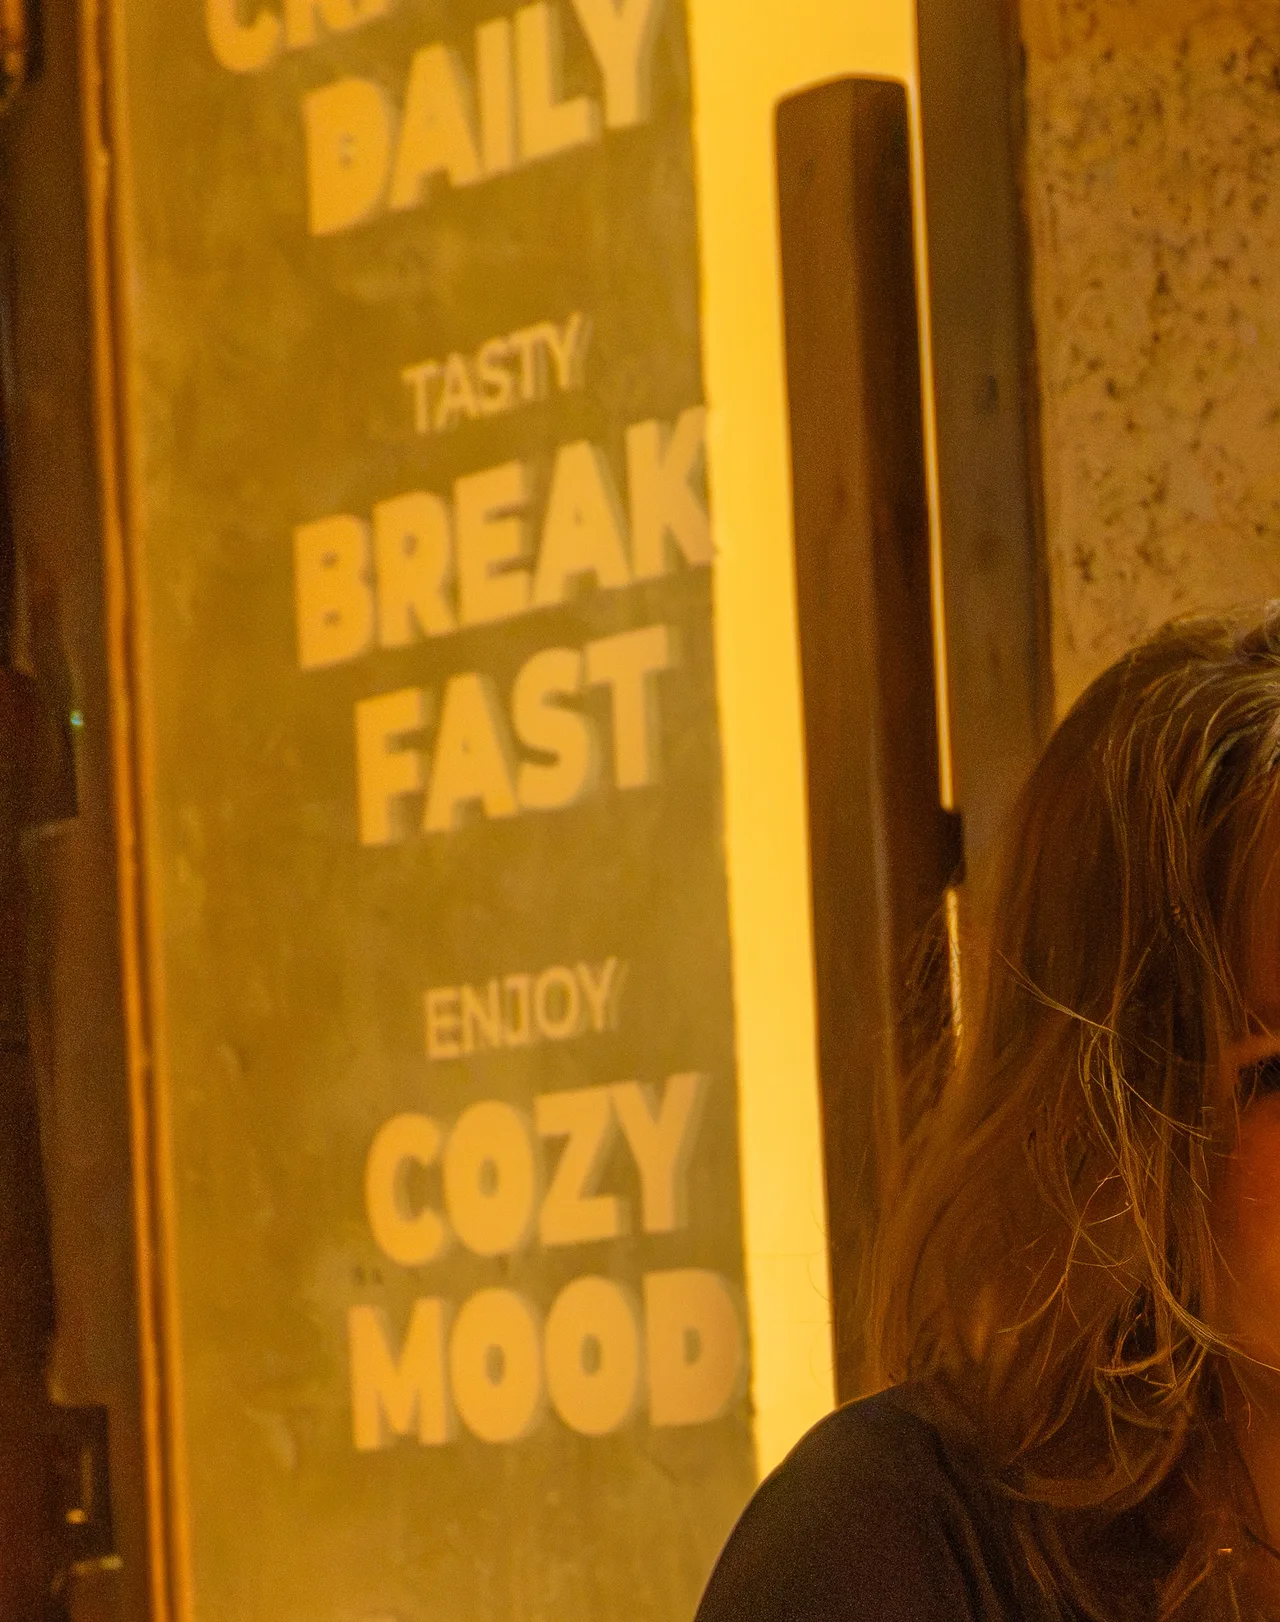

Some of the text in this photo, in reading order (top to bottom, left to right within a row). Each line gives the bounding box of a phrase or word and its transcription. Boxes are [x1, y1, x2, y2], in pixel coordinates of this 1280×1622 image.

[304, 0, 656, 236] DAILY
[401, 313, 594, 433] TASTY
[294, 406, 716, 671] BREAK
[354, 625, 674, 846] FAST
[424, 957, 621, 1060] ENJOY
[365, 1071, 706, 1266] COZY
[347, 1268, 742, 1450] MOOD
